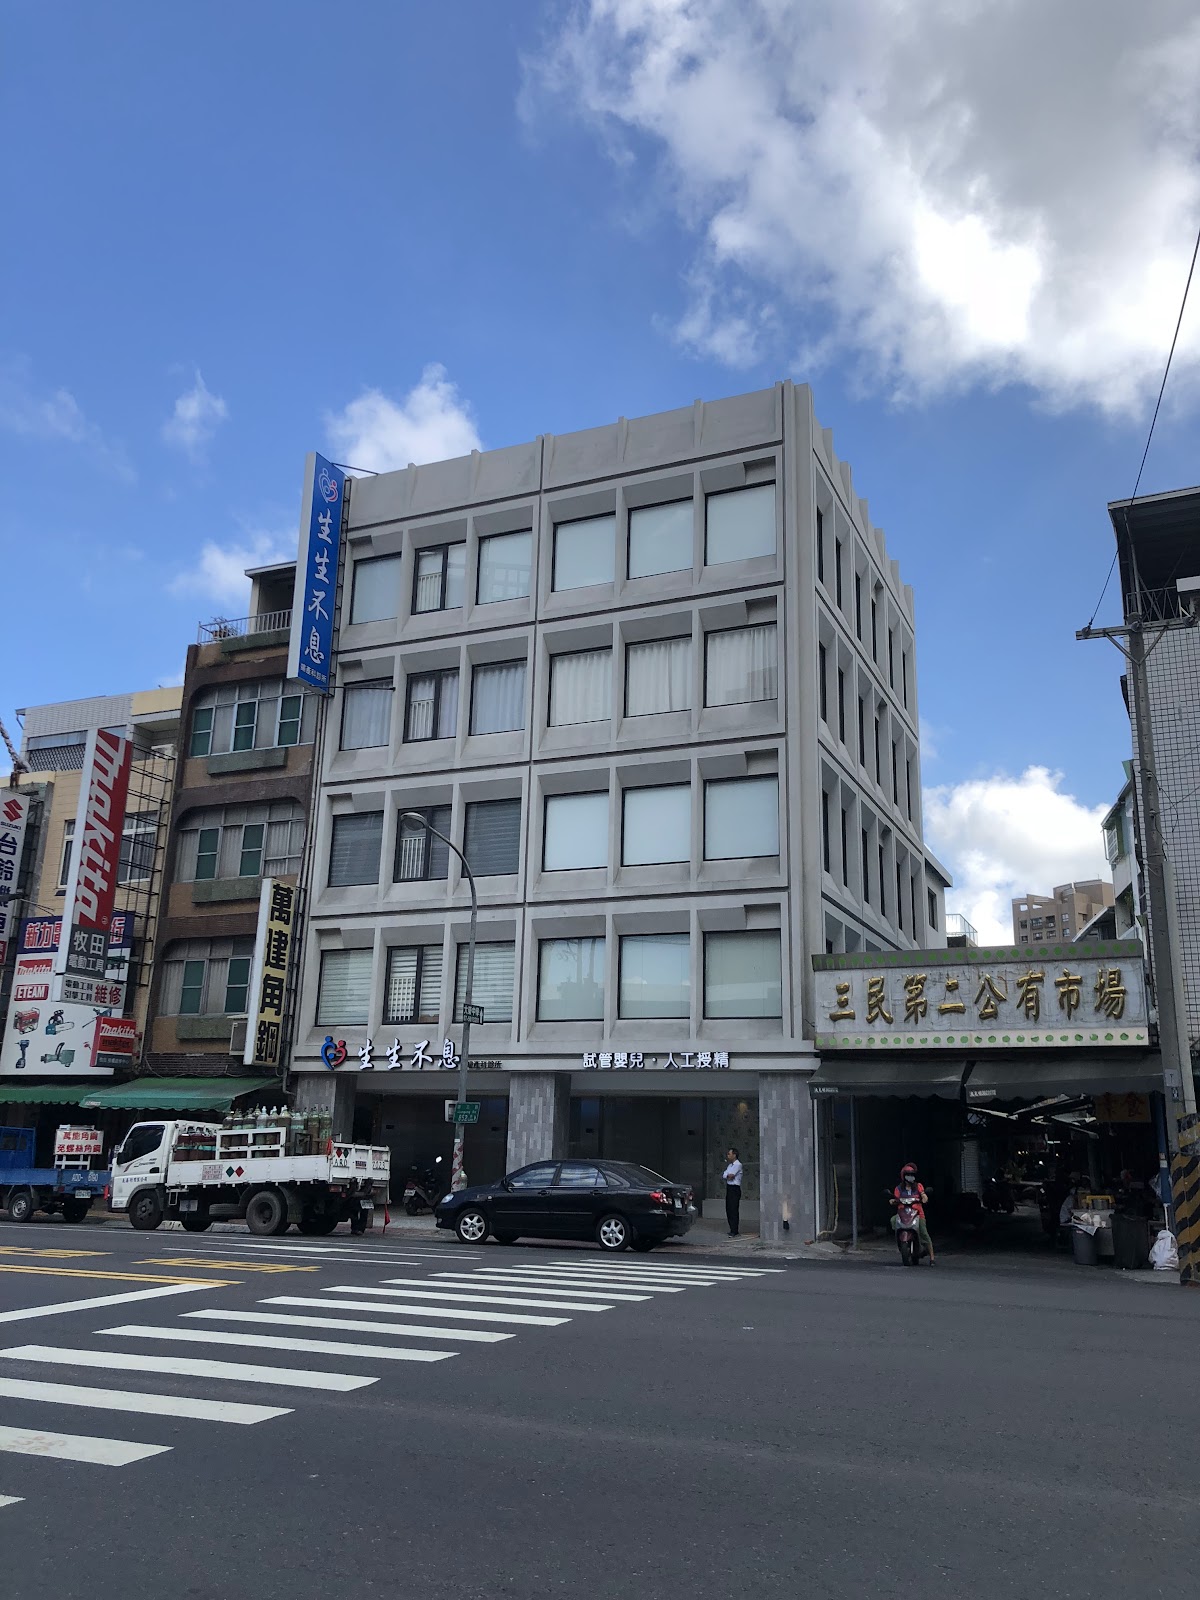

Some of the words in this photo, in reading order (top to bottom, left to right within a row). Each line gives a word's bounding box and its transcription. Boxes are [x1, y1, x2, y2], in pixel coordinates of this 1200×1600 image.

[304, 508, 334, 665] 生生不息
[73, 930, 105, 956] 牧田
[68, 954, 105, 973] 電動工具
[256, 883, 293, 1062] 萬建角鋼
[94, 984, 122, 1005] 維修
[829, 967, 1127, 1026] 三民第二公有市場
[357, 1037, 461, 1070] 生生不息
[63, 1131, 98, 1141] 萬能角鋼
